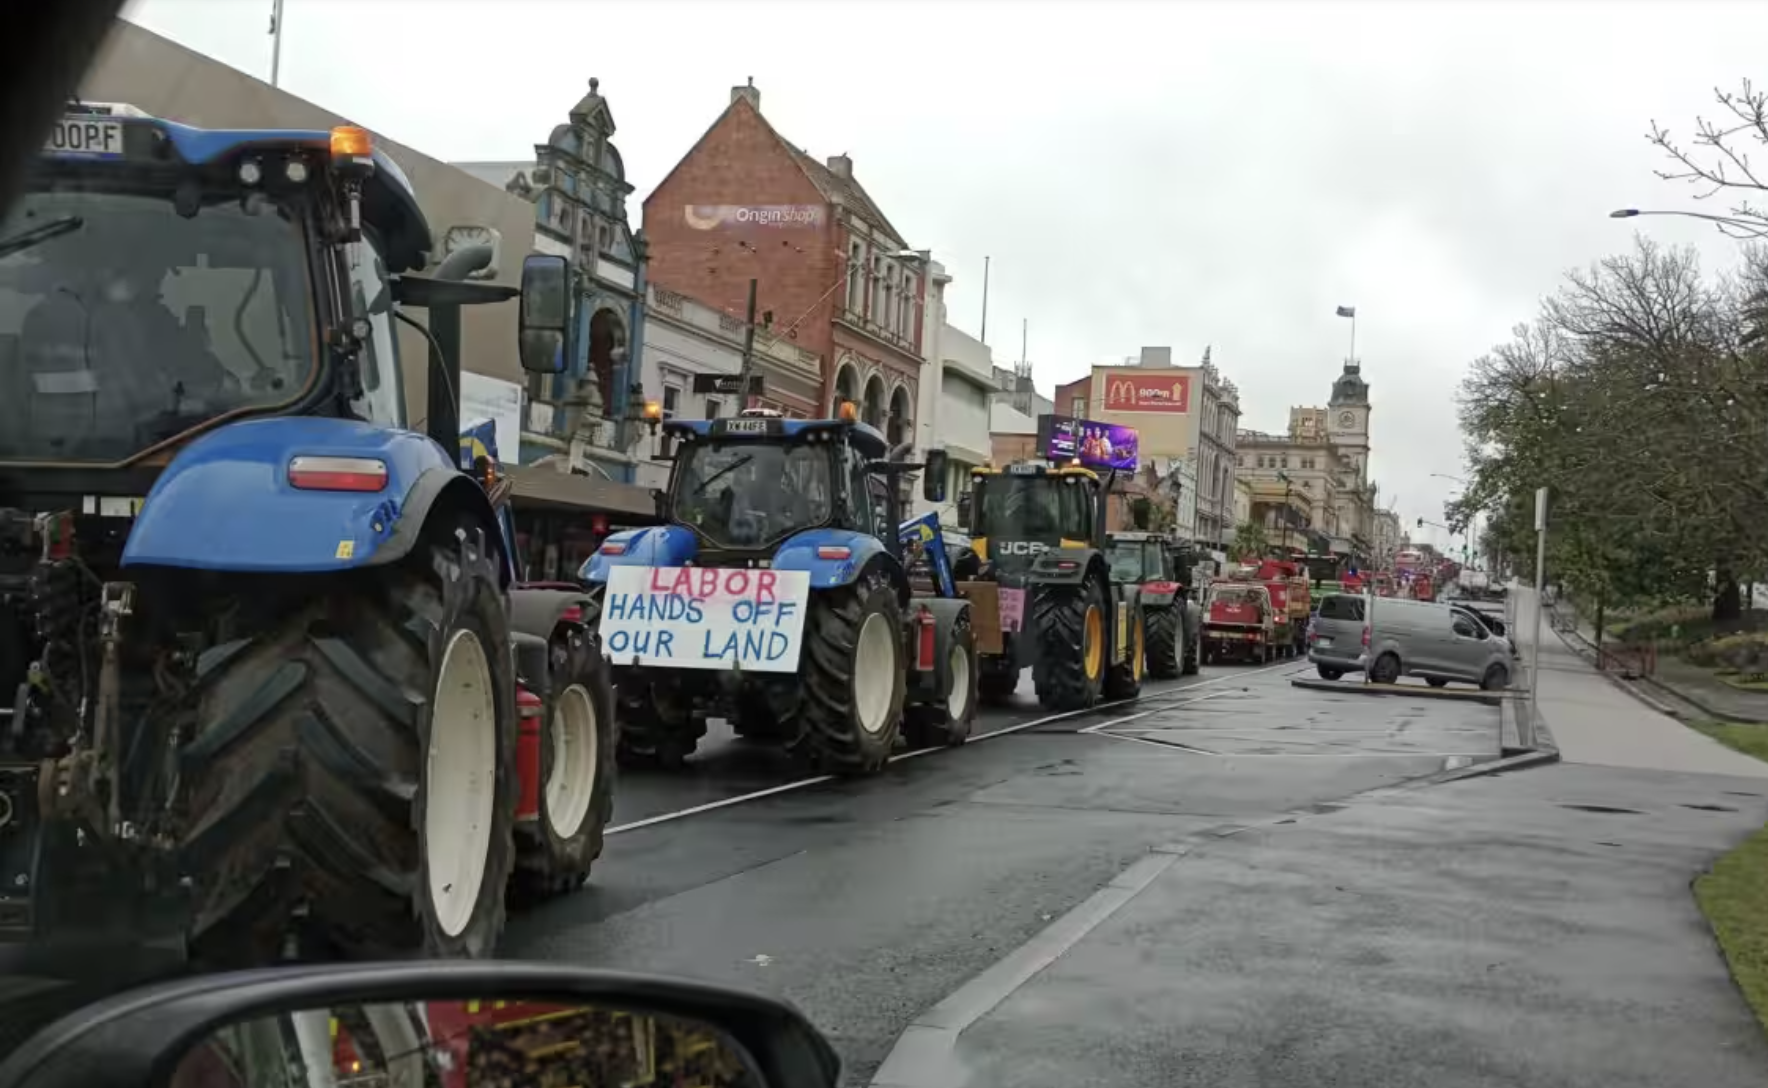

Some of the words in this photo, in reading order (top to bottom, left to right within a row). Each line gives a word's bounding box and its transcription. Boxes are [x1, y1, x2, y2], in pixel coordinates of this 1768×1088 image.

[736, 207, 780, 225] Origin
[651, 567, 776, 603] LABOR
[608, 593, 704, 623] HANDS
[731, 600, 796, 627] OFF
[608, 629, 674, 657] OUR
[703, 629, 789, 660] LAND
